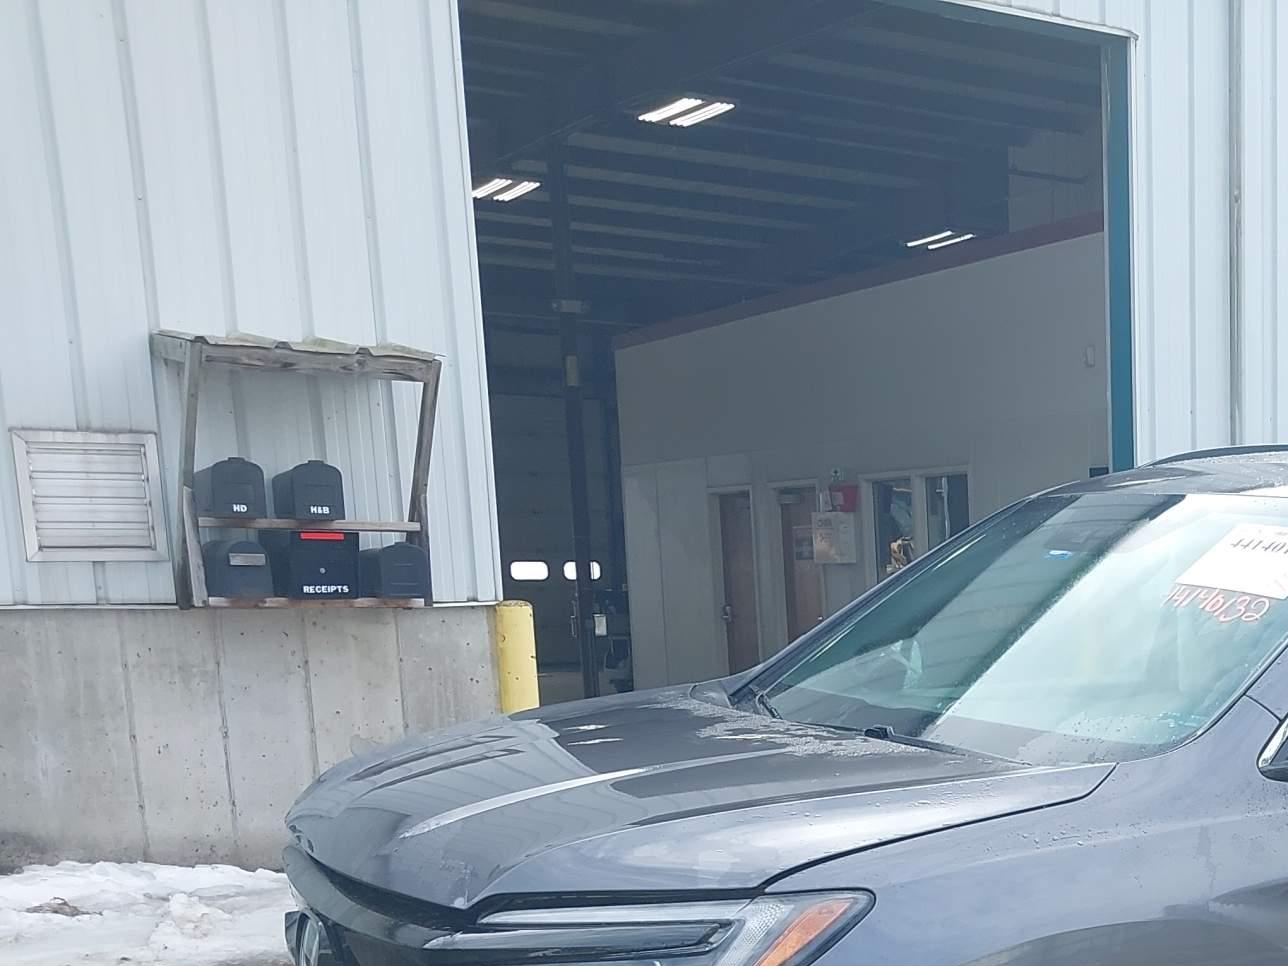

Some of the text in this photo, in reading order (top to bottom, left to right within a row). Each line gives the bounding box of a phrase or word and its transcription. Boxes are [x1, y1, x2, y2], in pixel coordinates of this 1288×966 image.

[233, 504, 247, 513] HD
[311, 506, 330, 514] H&B
[303, 585, 349, 594] RECEIPTS
